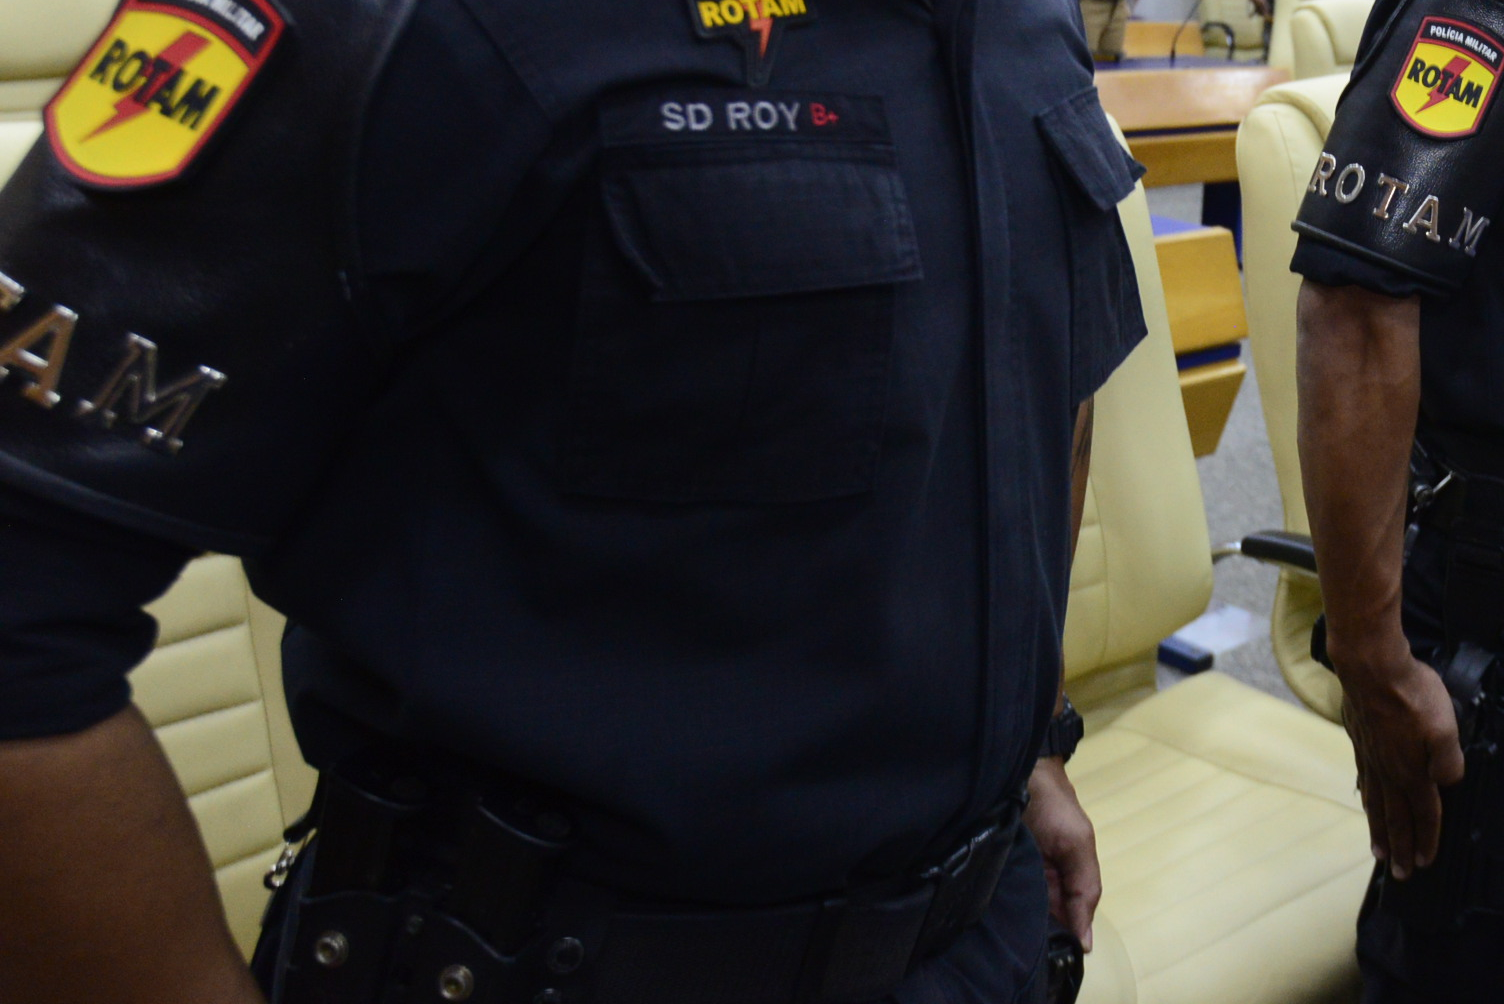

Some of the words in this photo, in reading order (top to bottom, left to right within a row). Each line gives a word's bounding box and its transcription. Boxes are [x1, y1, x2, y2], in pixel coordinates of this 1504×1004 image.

[1430, 25, 1464, 44] POLÍCIA
[1465, 35, 1498, 63] MILITAR
[89, 38, 220, 131] ROTAM
[661, 101, 713, 131] SD
[727, 100, 800, 131] ROY
[1406, 56, 1484, 109] ROTAM
[1308, 151, 1490, 257] ROTAM
[0, 271, 229, 455] AM
